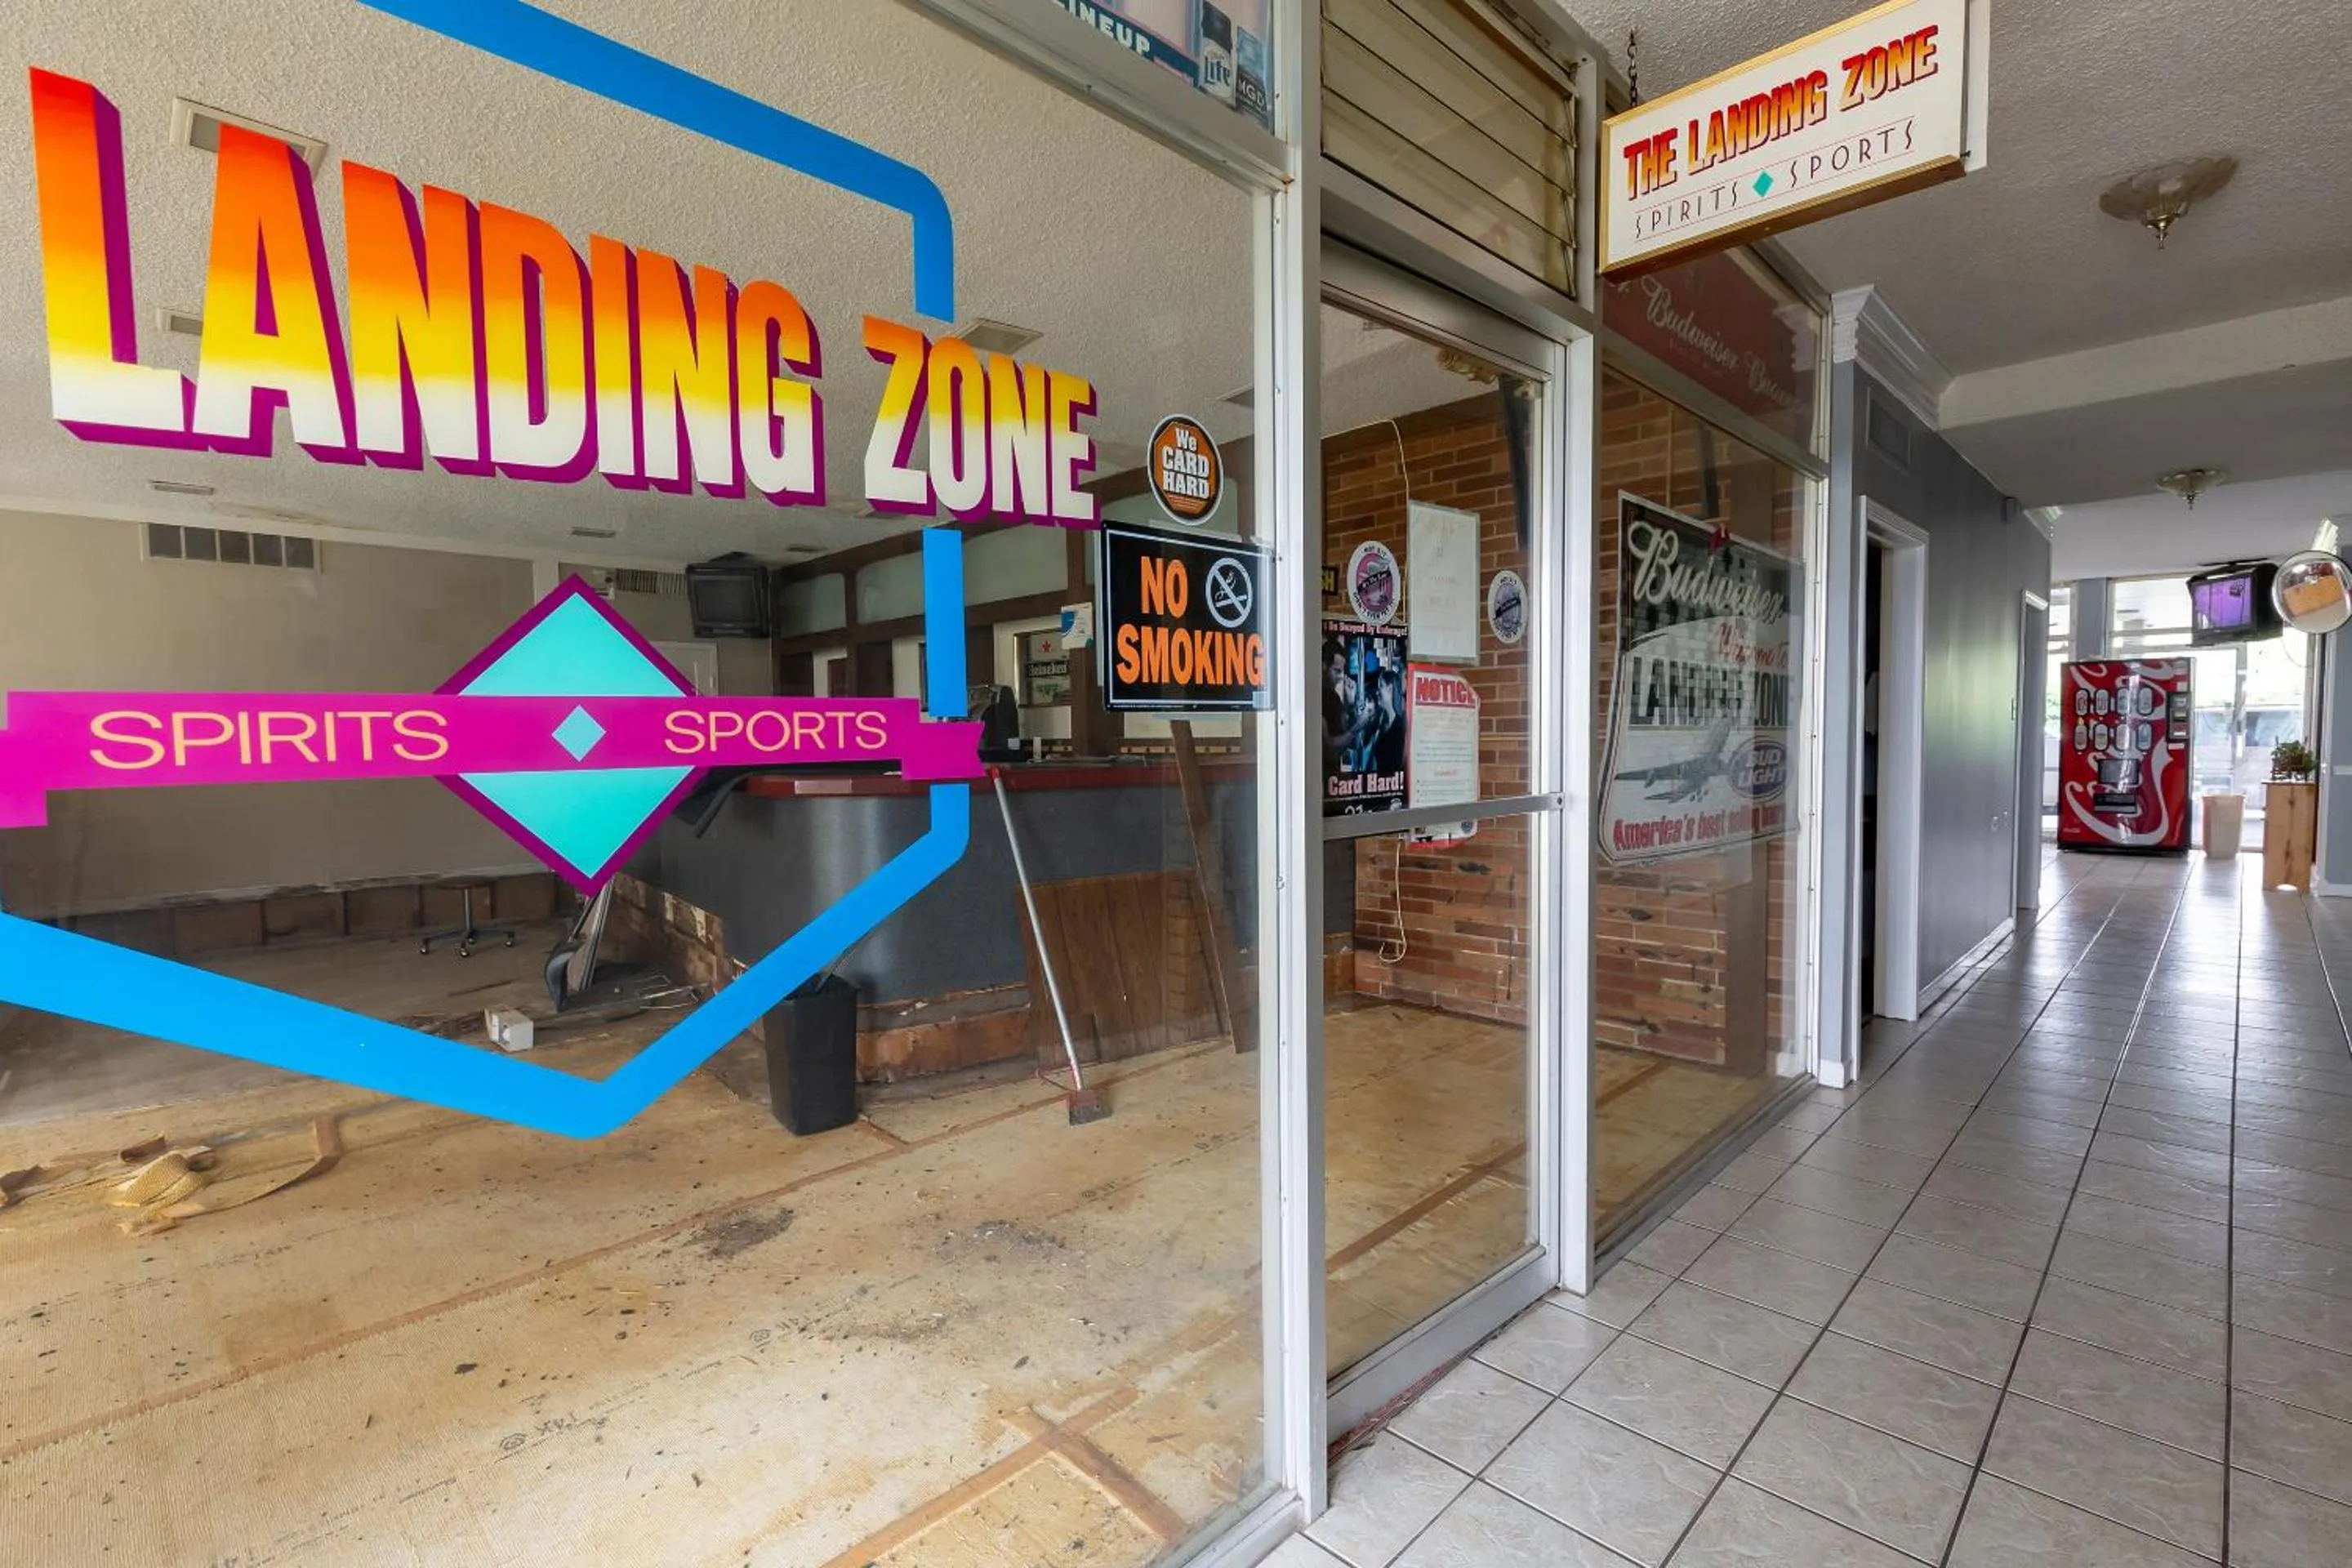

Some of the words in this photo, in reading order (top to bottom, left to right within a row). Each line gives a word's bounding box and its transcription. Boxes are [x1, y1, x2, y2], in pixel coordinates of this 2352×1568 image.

[1053, 0, 1152, 56] INEUP
[1623, 127, 1678, 201] THE
[1688, 69, 1829, 176] LANDING
[1840, 24, 1939, 112] ZONE
[1636, 180, 1738, 239] SPIRITS
[1790, 118, 1913, 188] SPORTS
[29, 65, 826, 506] LANDING
[862, 314, 1102, 531] ZONE
[1161, 445, 1209, 479] CARD
[1175, 426, 1197, 452] We
[1163, 469, 1209, 500] HARD
[1141, 555, 1188, 619] NO
[1627, 520, 1784, 626] Budweiser
[1116, 623, 1265, 686] SMOKING
[89, 710, 450, 770] SPIRITS
[663, 710, 889, 753] SPORTS
[1746, 748, 1781, 768] BUD
[1328, 775, 1363, 795] Card
[1366, 771, 1405, 792] Hard!
[1737, 766, 1788, 789] LIGHT
[1613, 813, 1694, 852] America's
